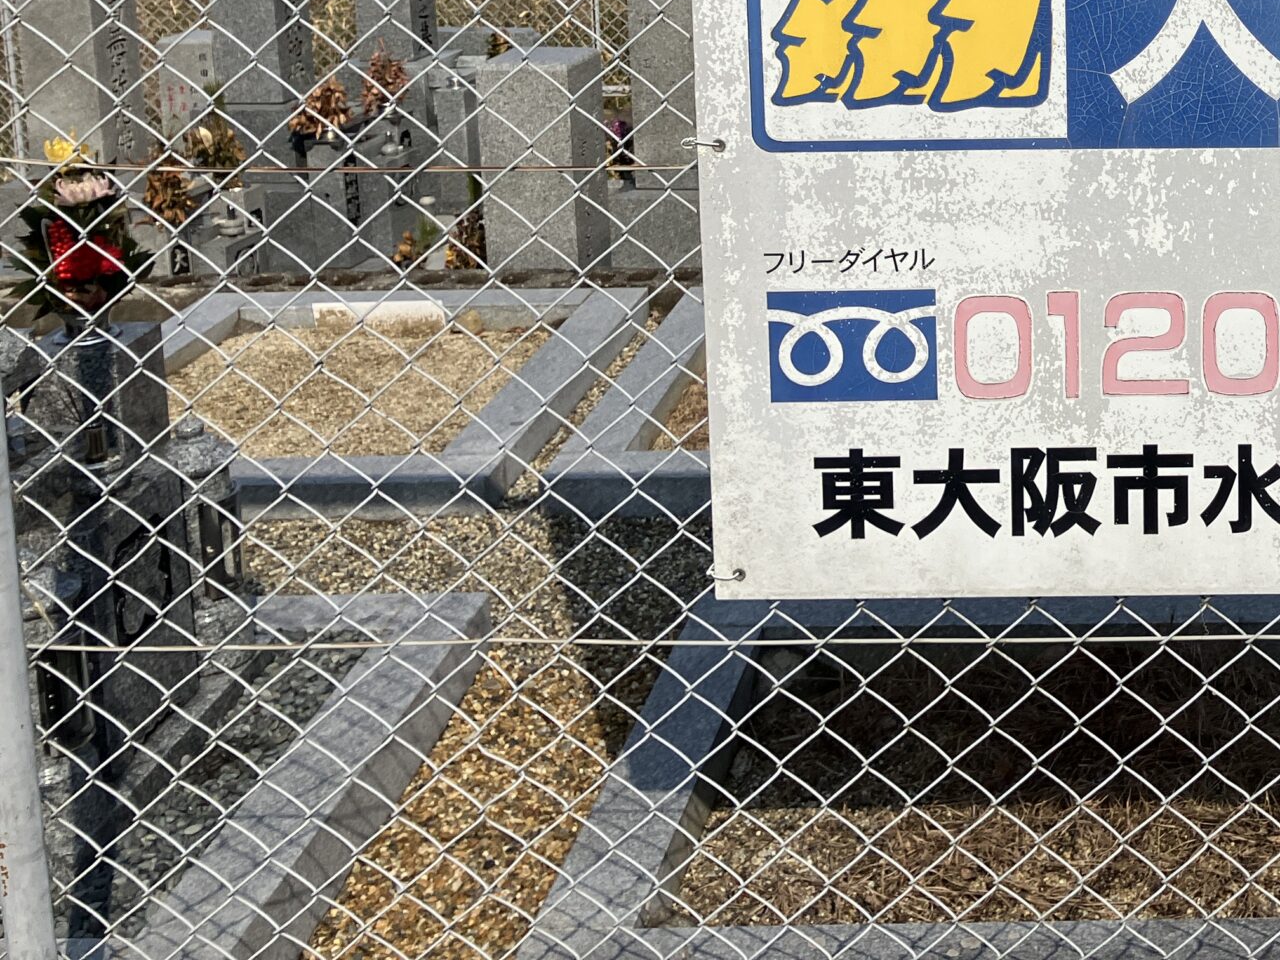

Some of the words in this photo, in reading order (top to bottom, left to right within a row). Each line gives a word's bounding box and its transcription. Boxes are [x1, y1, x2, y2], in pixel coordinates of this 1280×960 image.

[763, 247, 936, 274] フリーダイヤル
